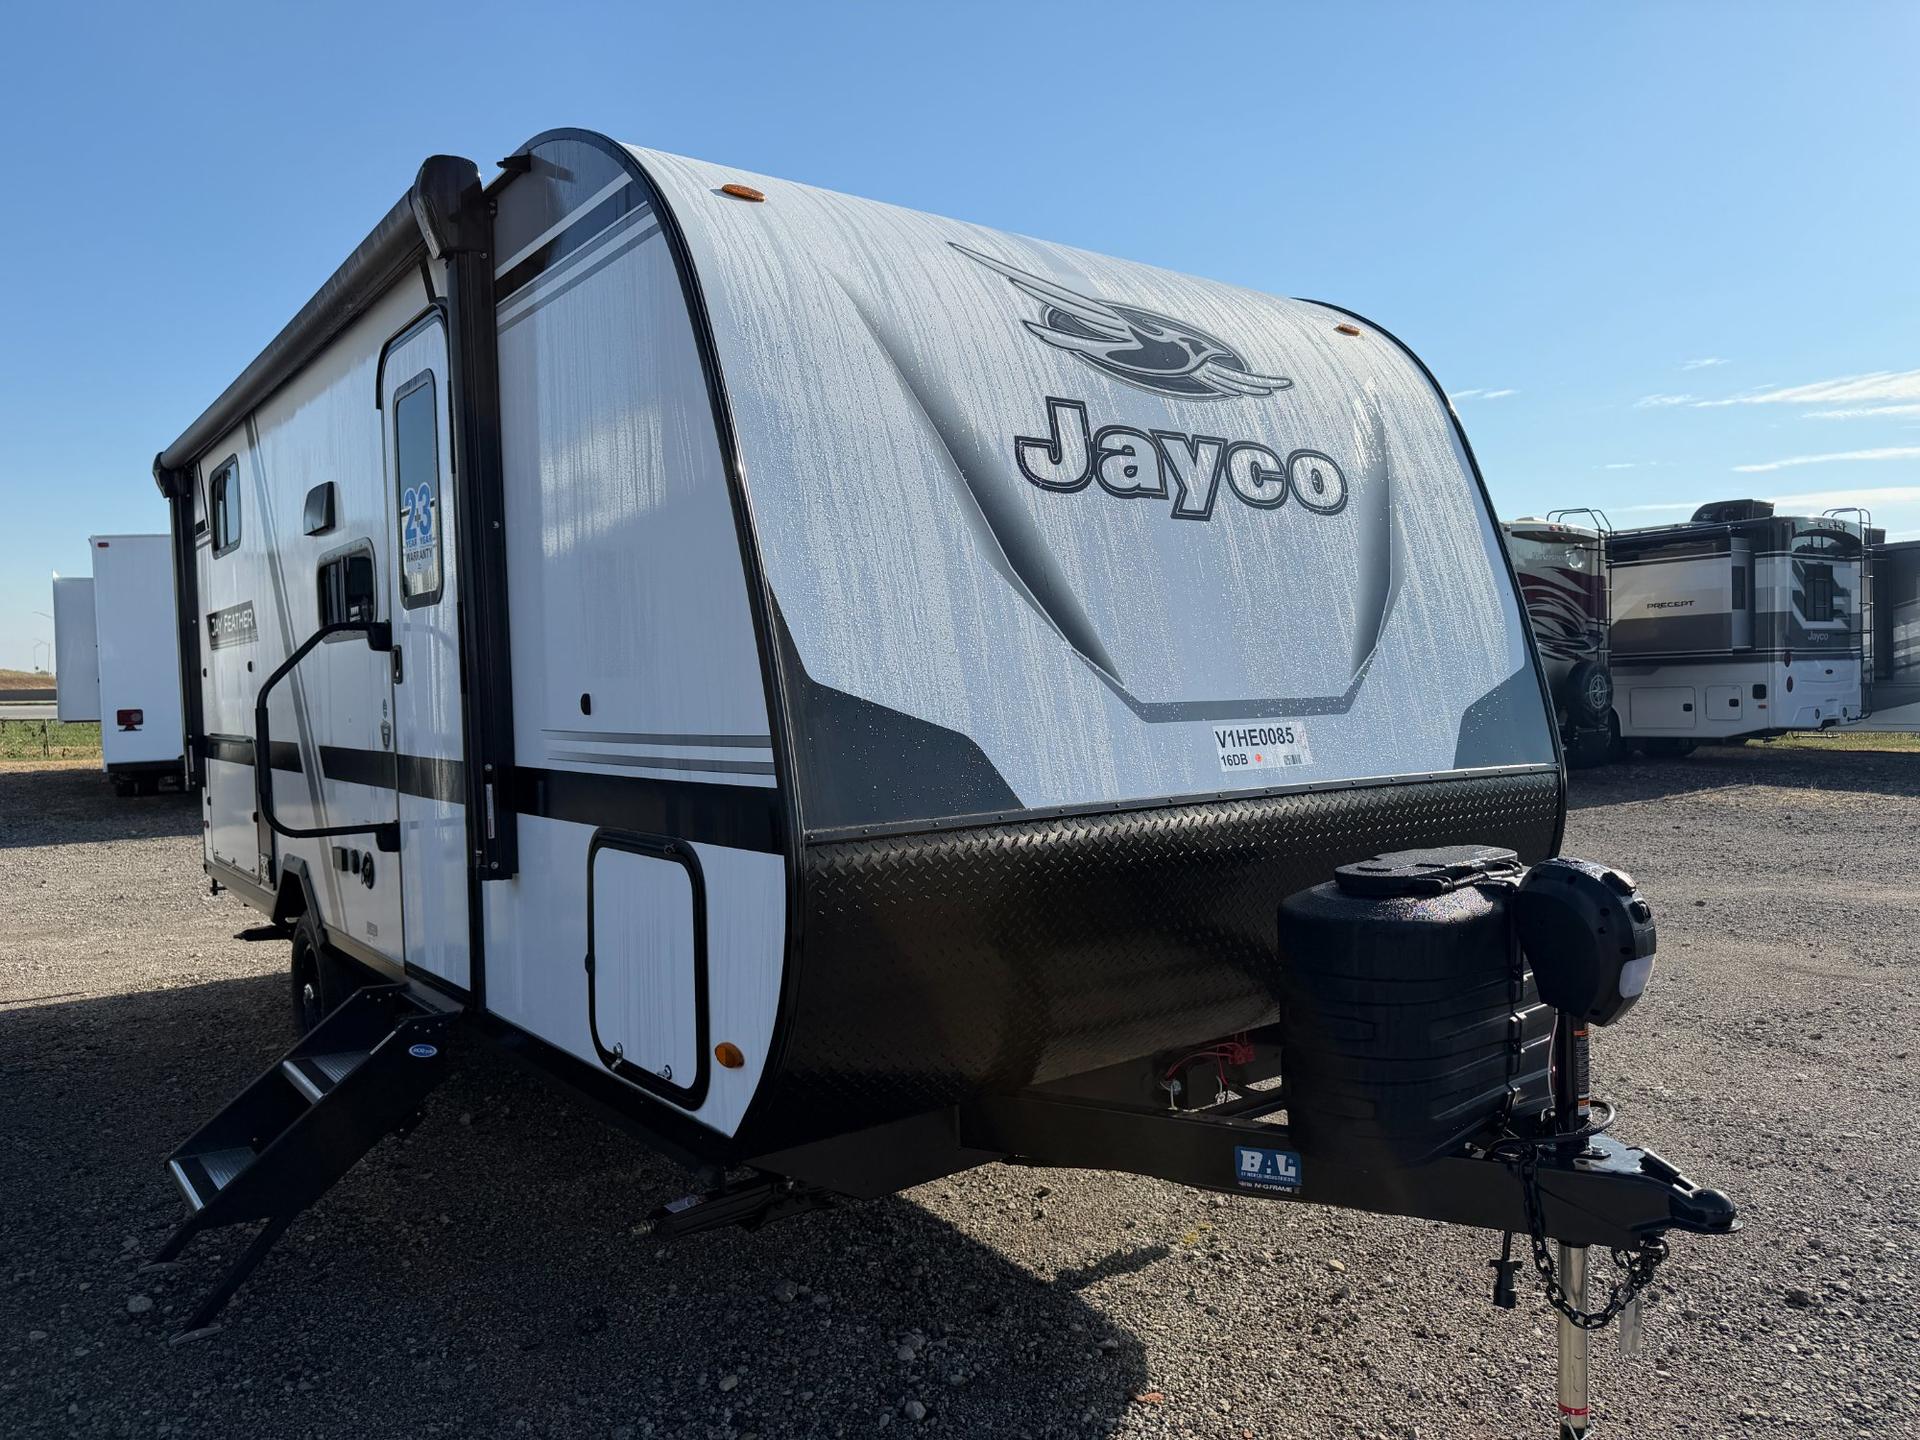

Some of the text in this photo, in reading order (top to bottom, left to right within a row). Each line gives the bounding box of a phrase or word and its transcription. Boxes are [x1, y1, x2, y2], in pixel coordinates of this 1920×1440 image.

[1014, 396, 1348, 521] Jayco
[406, 547, 433, 562] WARRANTY
[1646, 600, 1696, 609] PRECEPT
[223, 608, 253, 634] FEATHER
[1807, 631, 1829, 643] Jayco
[1215, 727, 1295, 748] V1HE0085
[1221, 753, 1248, 767] 16DB
[1240, 1150, 1296, 1177] BAL
